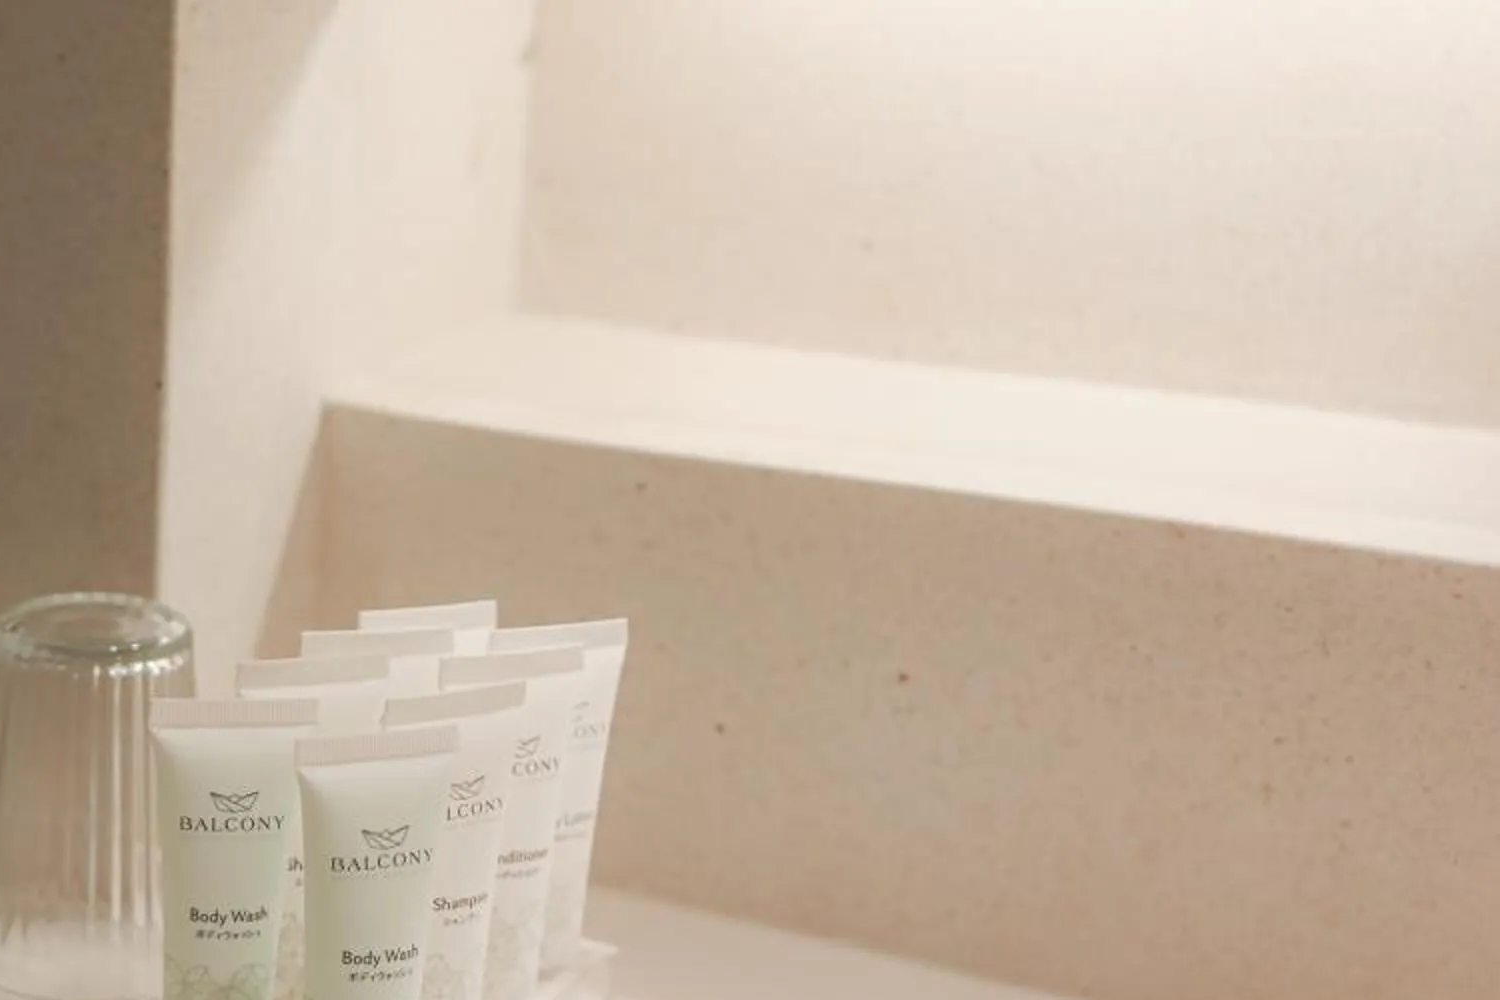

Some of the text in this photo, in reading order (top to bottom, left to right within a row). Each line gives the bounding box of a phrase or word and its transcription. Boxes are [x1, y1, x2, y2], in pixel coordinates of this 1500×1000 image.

[511, 756, 559, 776] CONY
[446, 798, 503, 821] LCONY
[179, 815, 285, 832] BALCONY
[330, 847, 433, 873] BALCONY
[189, 905, 267, 926] Body Wash
[340, 943, 419, 968] Body Wash
